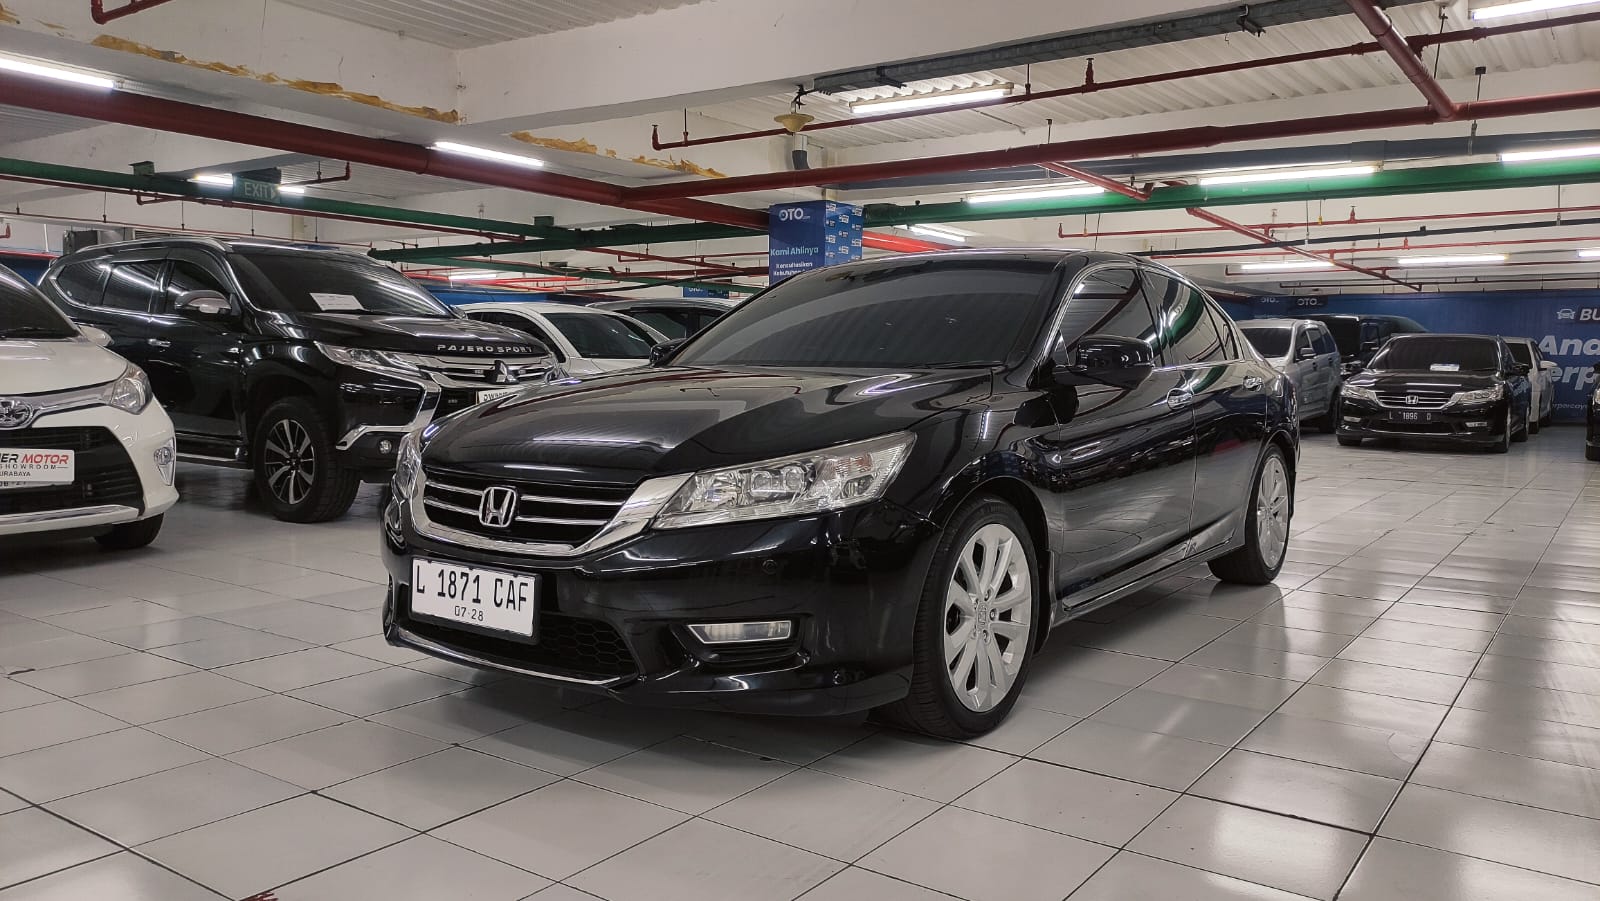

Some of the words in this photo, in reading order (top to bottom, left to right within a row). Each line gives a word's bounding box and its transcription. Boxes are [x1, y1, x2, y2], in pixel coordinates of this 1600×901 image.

[244, 181, 268, 199] EXIT
[770, 247, 790, 257] Kami
[790, 246, 819, 256] Ahlinya
[437, 344, 494, 353] PAJERO
[0, 453, 19, 464] ER
[21, 453, 70, 465] MOTOR
[416, 564, 425, 594] L
[437, 568, 481, 604] 1871
[493, 578, 529, 612] CAF
